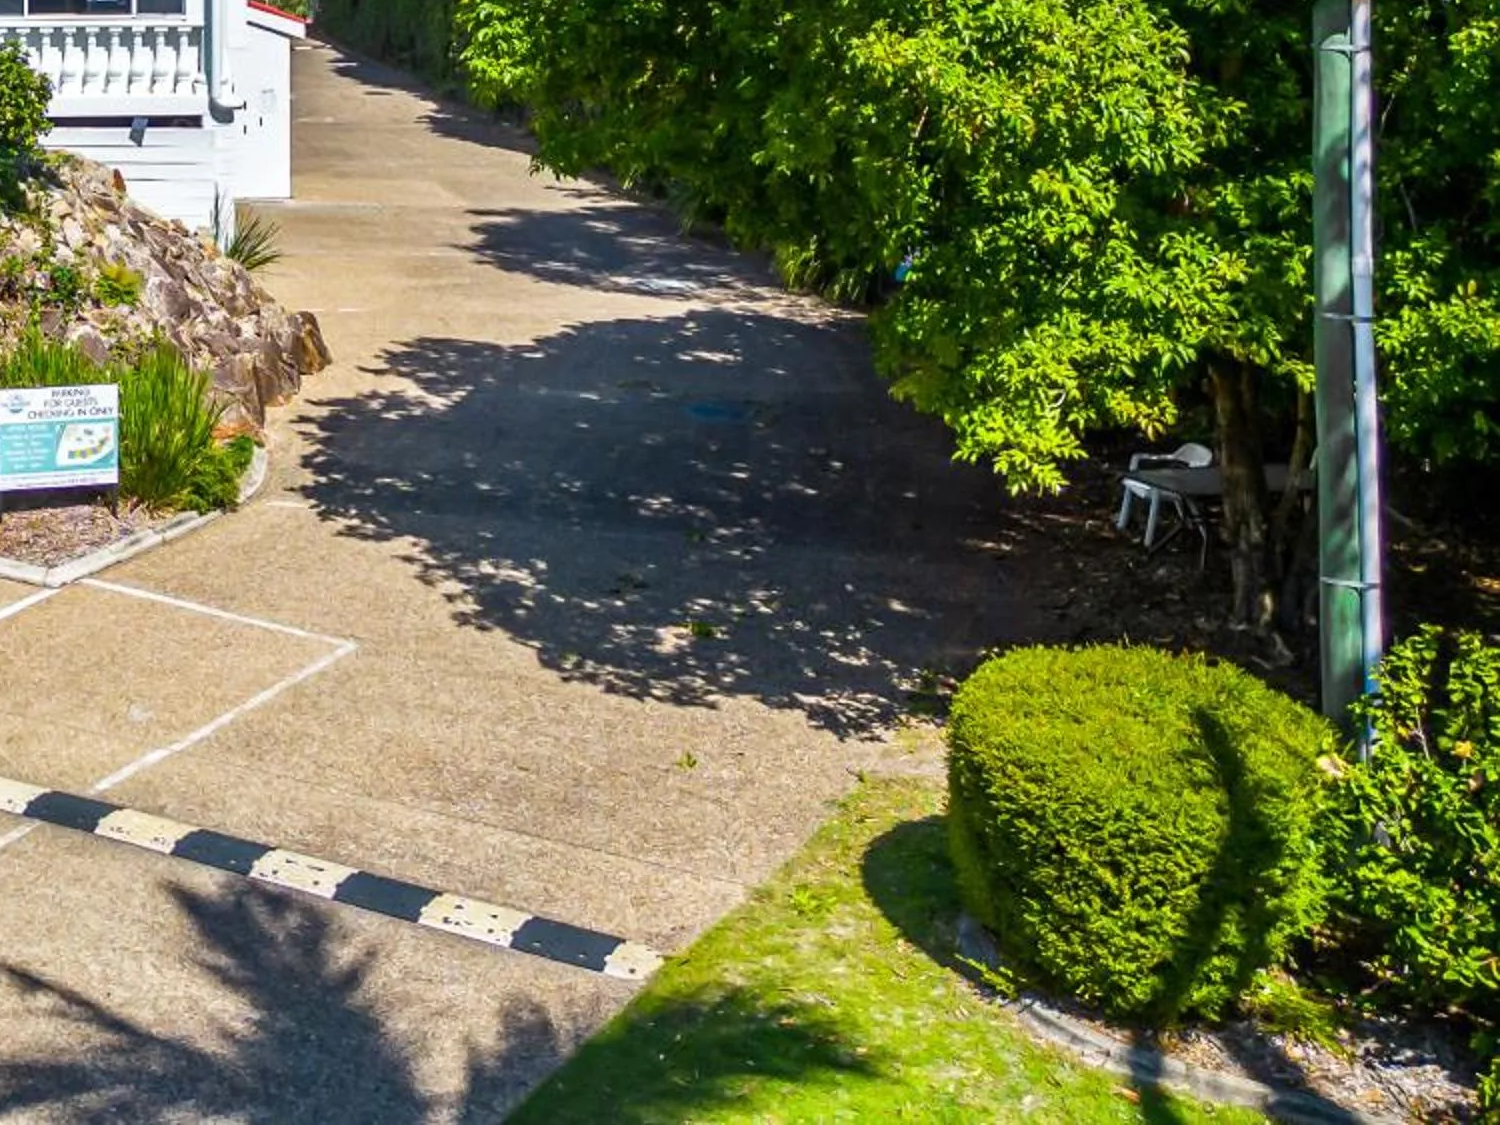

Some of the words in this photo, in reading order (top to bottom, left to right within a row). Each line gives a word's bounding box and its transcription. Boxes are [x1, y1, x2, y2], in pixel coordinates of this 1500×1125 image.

[44, 399, 61, 407] FOR
[64, 397, 98, 406] GUESTS
[28, 409, 75, 419] CHECKING
[90, 406, 114, 415] ONLY
